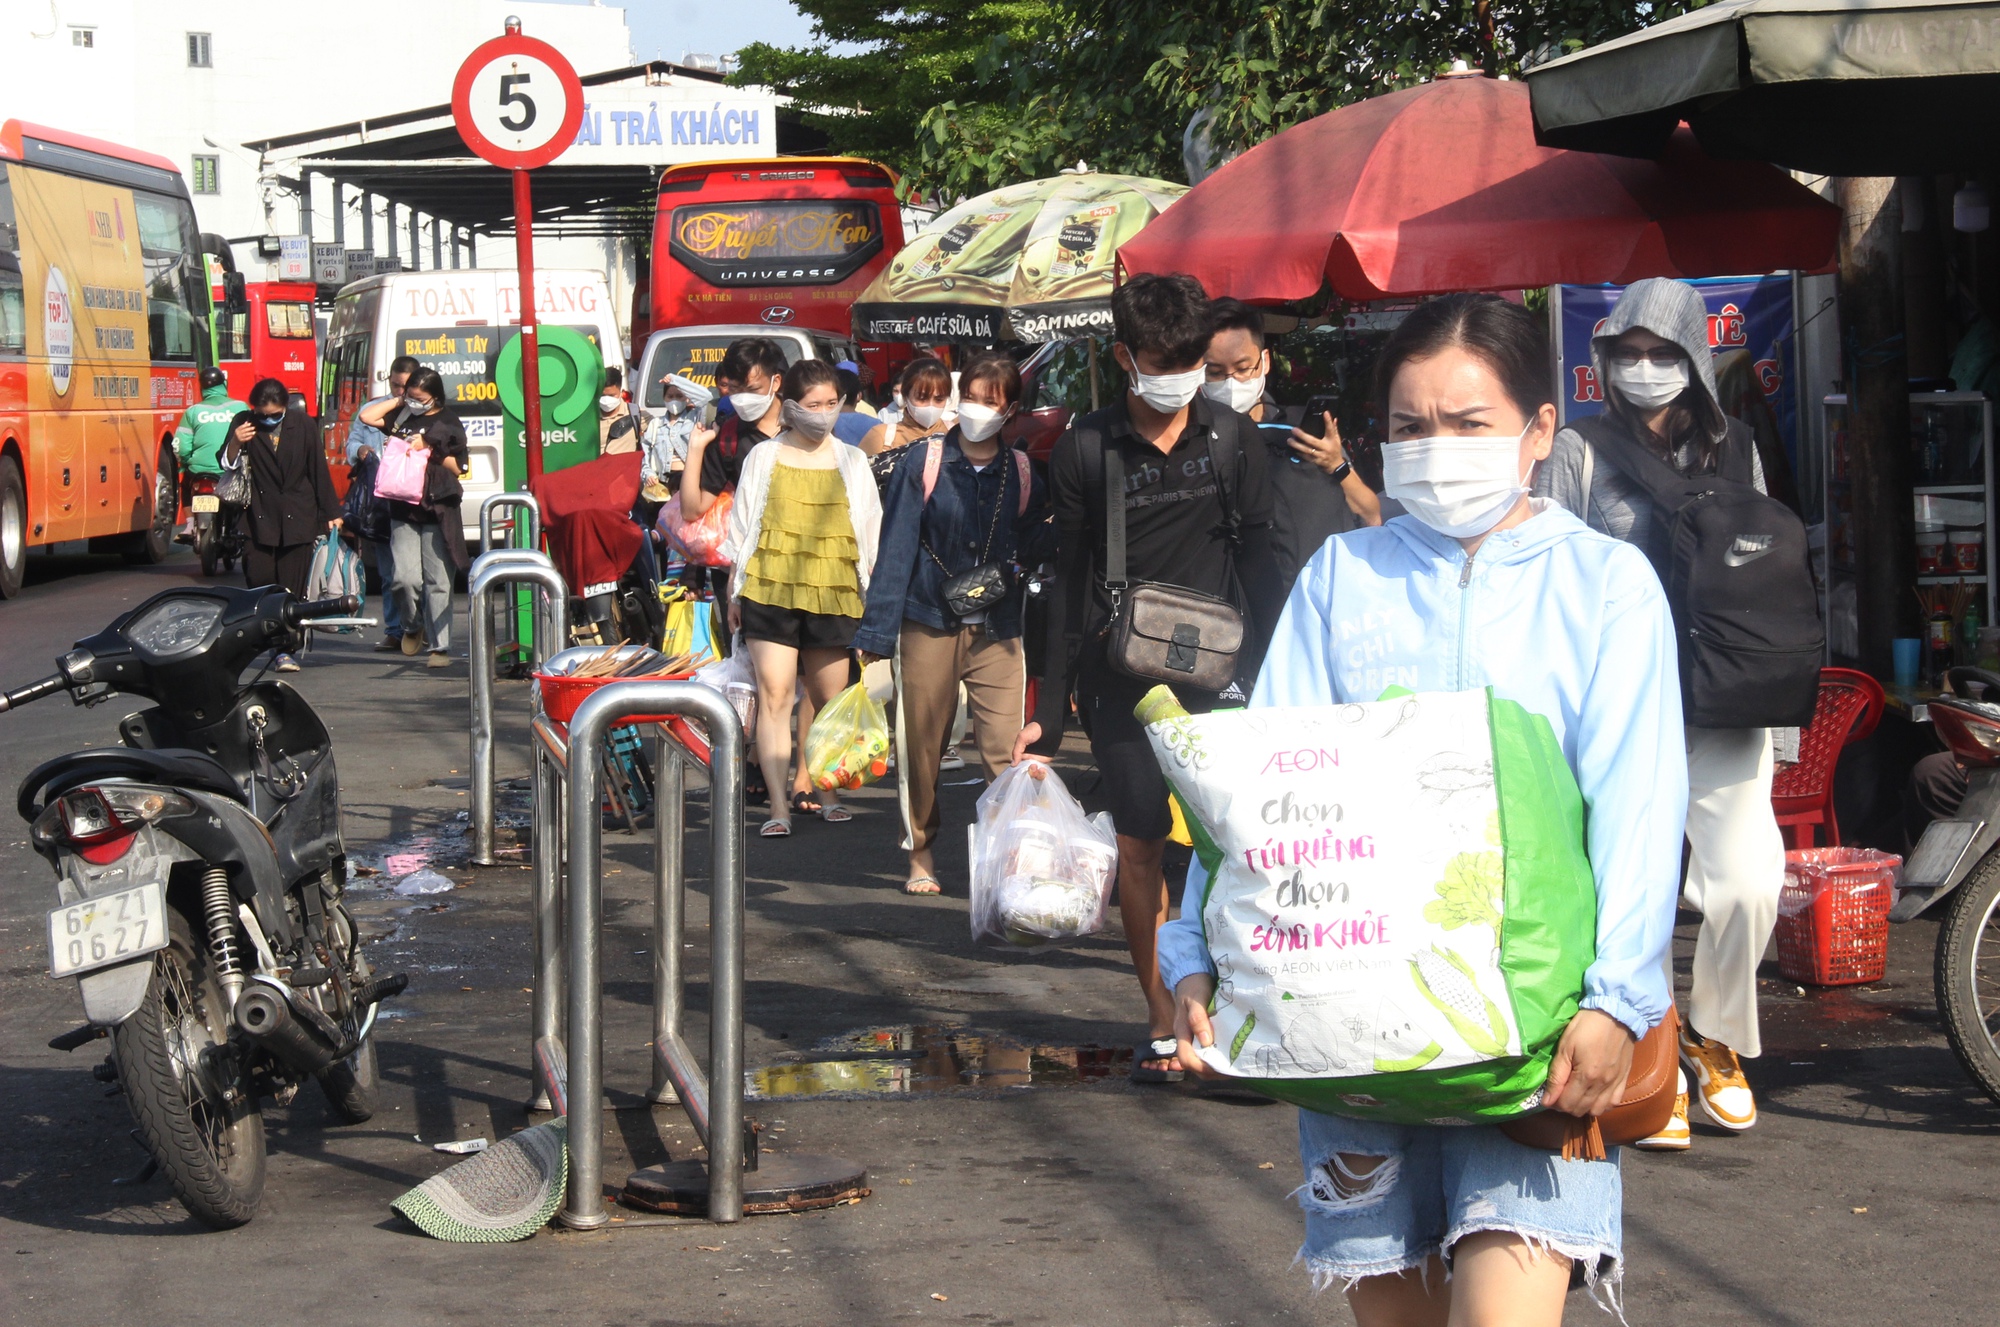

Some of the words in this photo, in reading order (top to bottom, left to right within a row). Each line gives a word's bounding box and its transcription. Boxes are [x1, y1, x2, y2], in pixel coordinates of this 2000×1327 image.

[1832, 20, 1909, 56] VIVA
[499, 73, 537, 132] 5
[571, 103, 602, 146] ÃI
[610, 101, 663, 146] TRẢ
[671, 101, 759, 145] KHÁCH
[95, 211, 113, 239] SHB
[281, 241, 289, 249] XE
[290, 239, 307, 250] BUÝT
[680, 212, 779, 260] Tuyết
[317, 247, 325, 256] XE
[326, 245, 344, 256] BUÝT
[359, 252, 373, 262] BUÝT
[325, 270, 337, 278] 144
[377, 261, 385, 269] XE
[386, 260, 401, 269] BUÝT
[720, 268, 836, 281] UNIVERSE
[406, 280, 476, 317] TOÀN
[498, 276, 597, 314] TẮNG
[48, 303, 62, 324] TOP
[1025, 314, 1063, 332] ĐẬM
[1063, 310, 1114, 331] NGON
[870, 316, 914, 334] NESCAFÉ
[917, 312, 947, 335] CAFÉ
[948, 313, 972, 336] SỮA
[975, 314, 992, 337] ĐÁ
[465, 334, 488, 353] TÂY
[690, 348, 701, 362] XE
[53, 364, 69, 379] AWARD
[456, 382, 497, 401] 1900
[197, 410, 236, 424] Grab
[518, 427, 578, 449] gjek
[1151, 491, 1179, 503] PARIS
[1733, 534, 1773, 551] NIKE
[1348, 631, 1395, 668] CHI
[1347, 665, 1419, 693] DREN
[1219, 692, 1246, 701] SPORTS
[1243, 837, 1286, 875] TÚI
[1250, 914, 1309, 954] SỐNG
[1314, 909, 1392, 950] KHỎE
[68, 919, 149, 968] 0627
[1281, 961, 1321, 974] AEON
[1324, 960, 1354, 973] Việt
